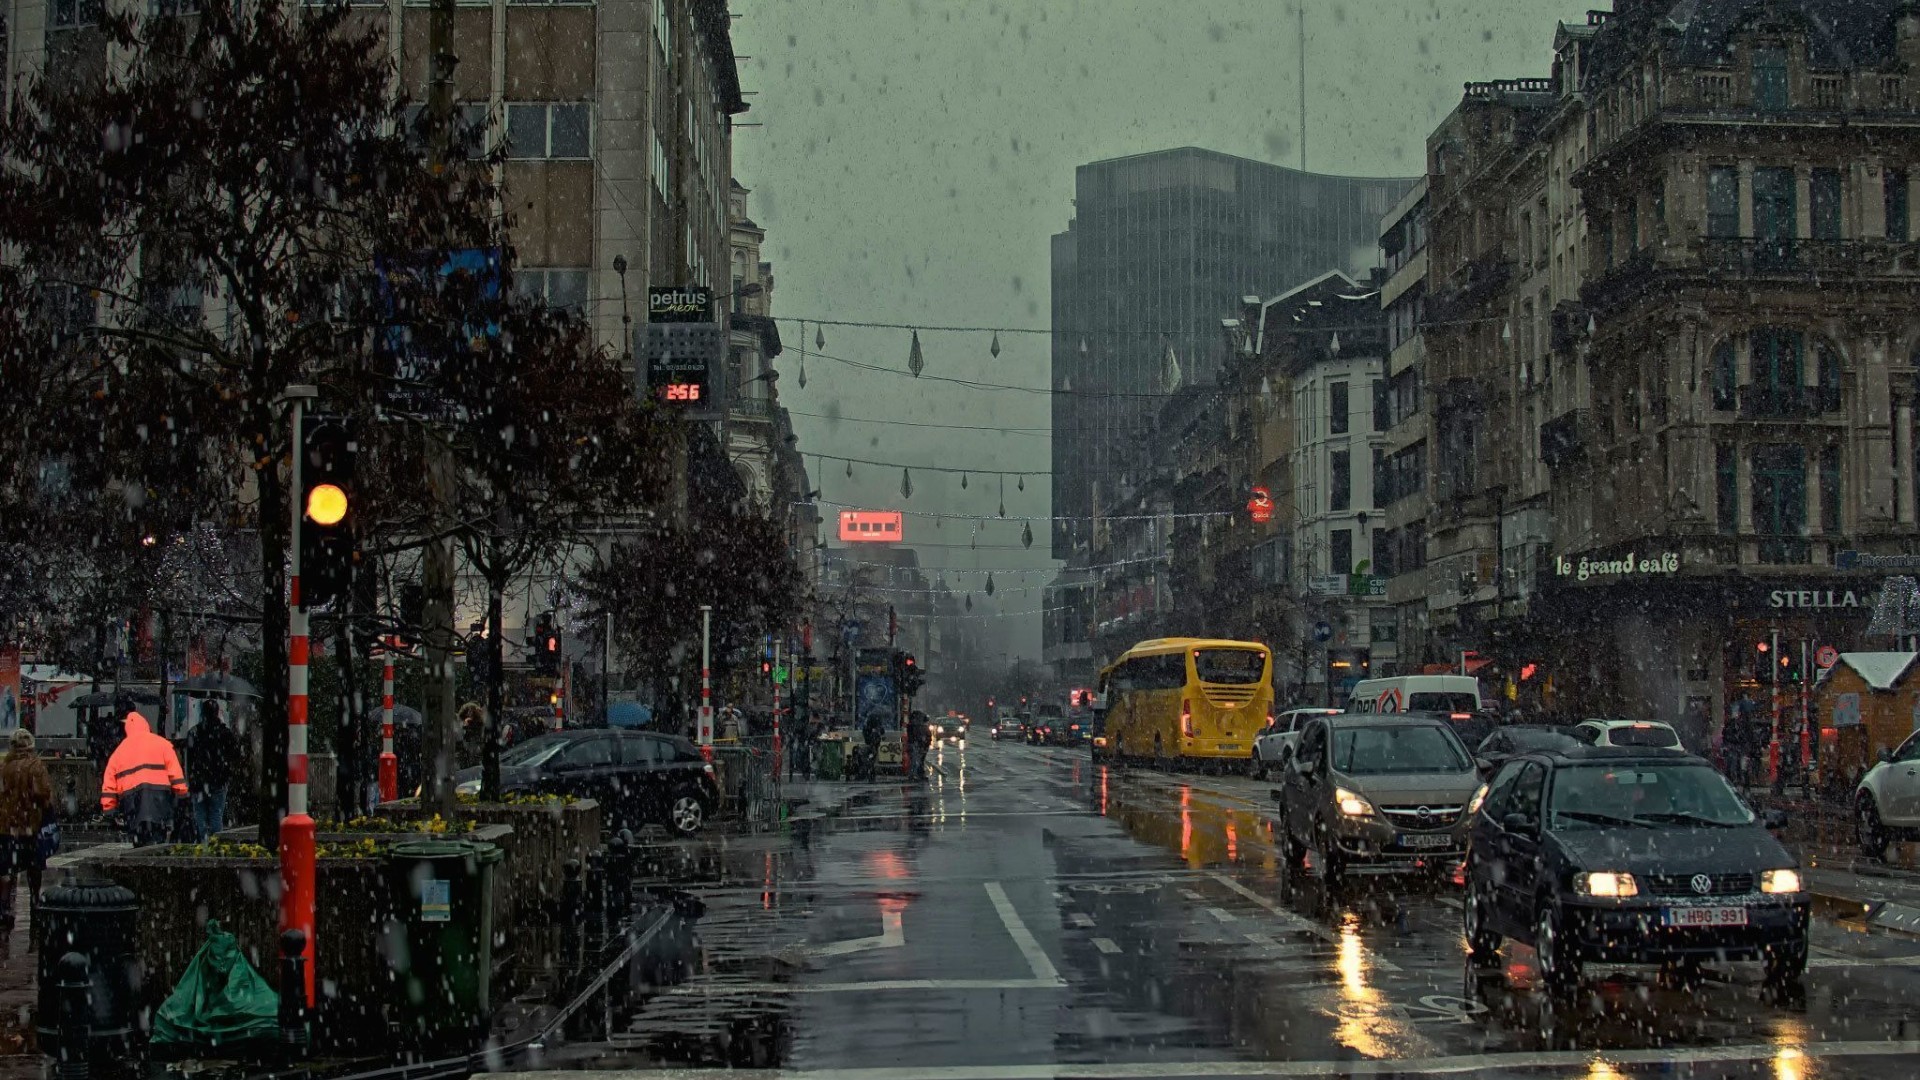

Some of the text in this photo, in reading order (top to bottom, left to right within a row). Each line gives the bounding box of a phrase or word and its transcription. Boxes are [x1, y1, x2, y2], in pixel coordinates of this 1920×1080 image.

[650, 290, 706, 309] petrus
[1556, 552, 1679, 580] le grand café
[1771, 590, 1859, 608] STELLA
